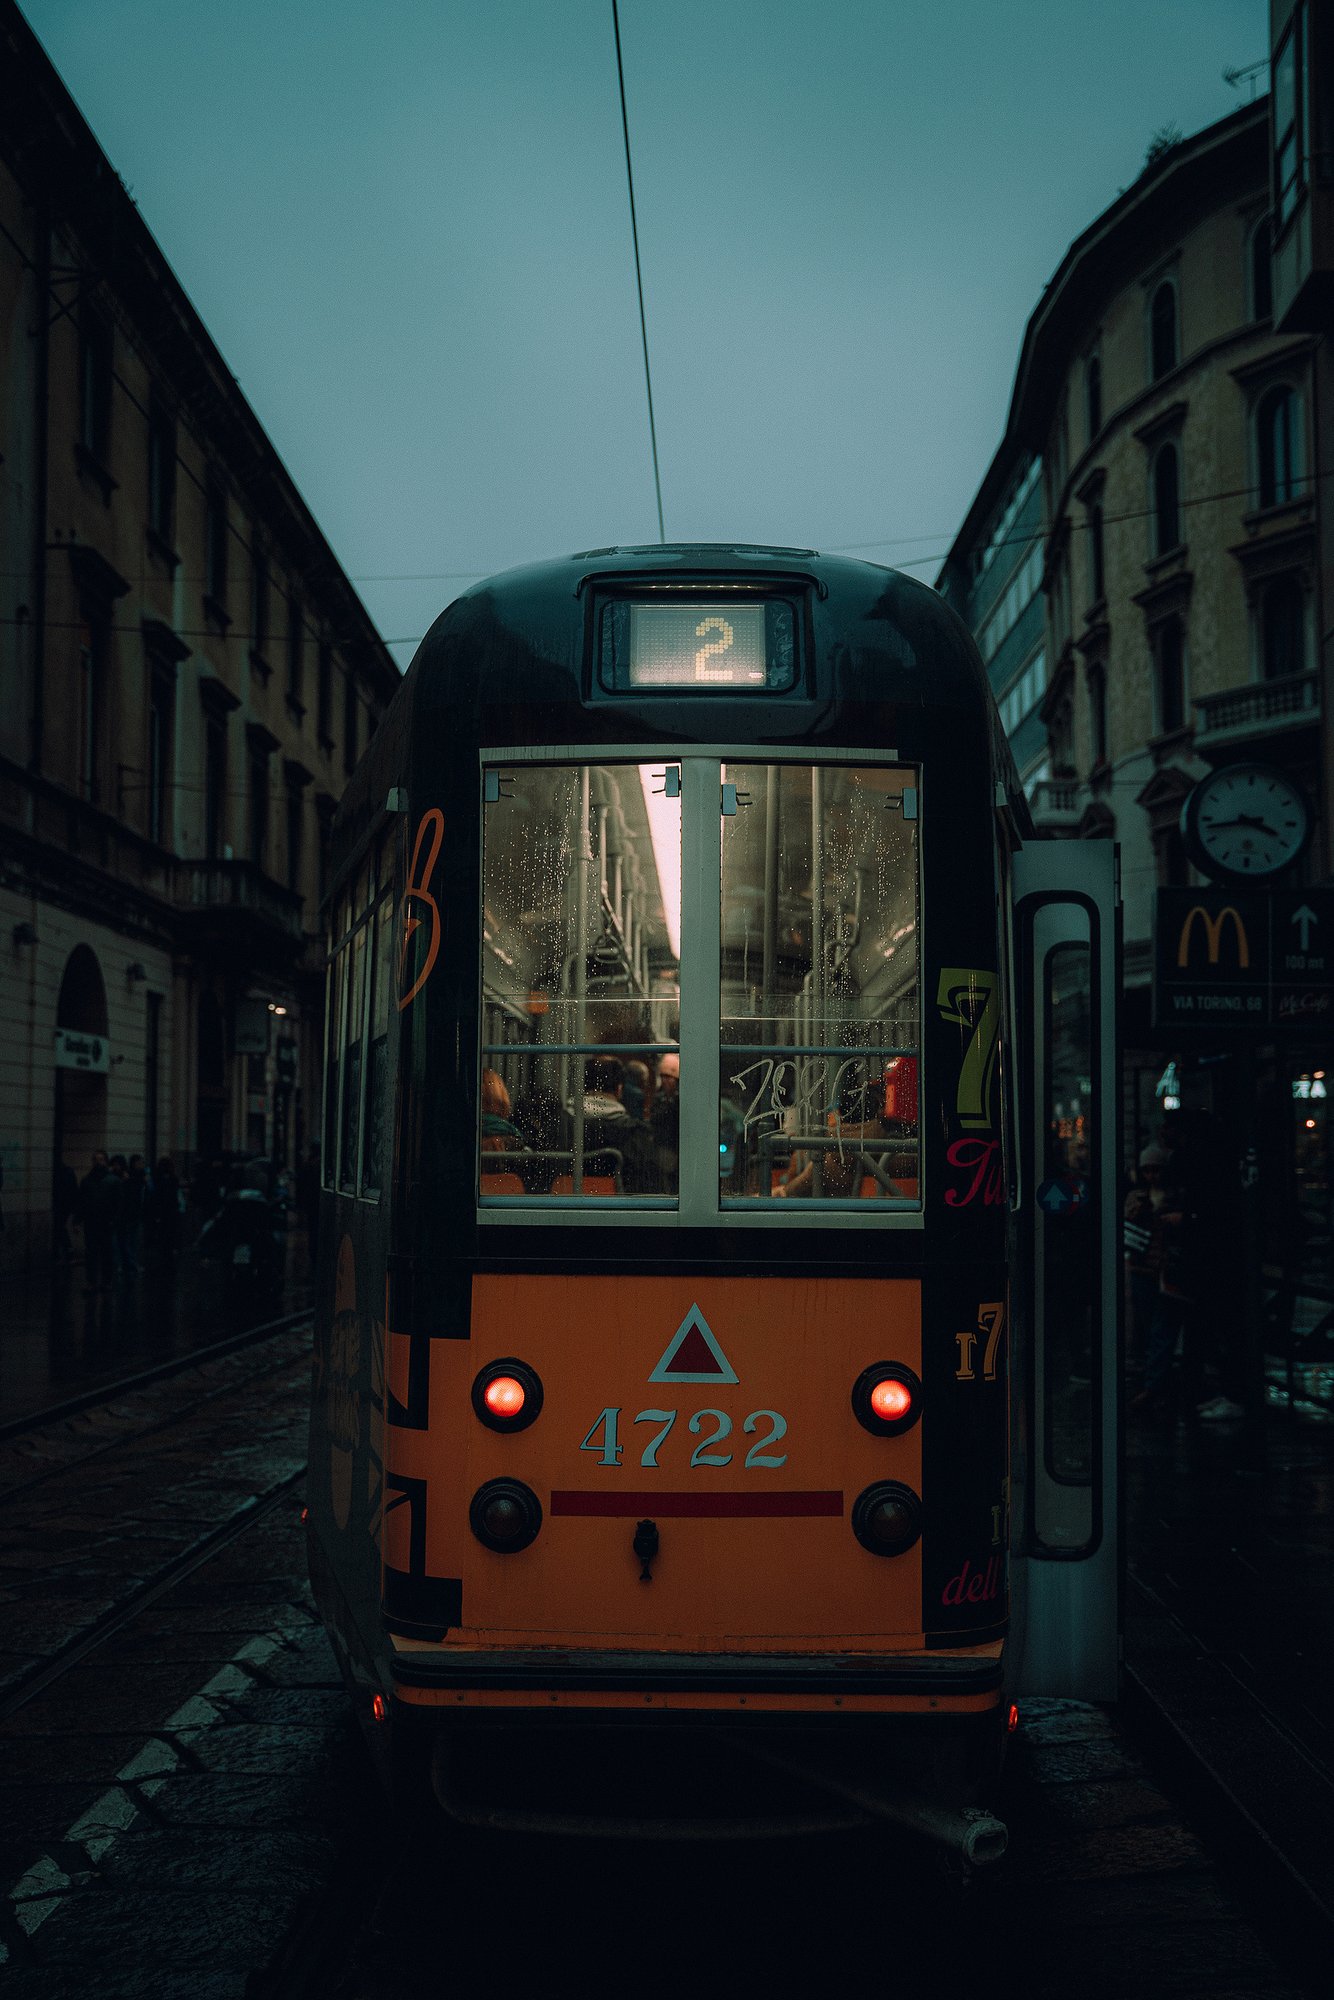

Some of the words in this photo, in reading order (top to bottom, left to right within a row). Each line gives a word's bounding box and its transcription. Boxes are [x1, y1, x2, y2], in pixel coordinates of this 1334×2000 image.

[696, 617, 733, 680] 2
[1173, 995, 1194, 1010] VIA
[579, 1407, 788, 1469] 4722
